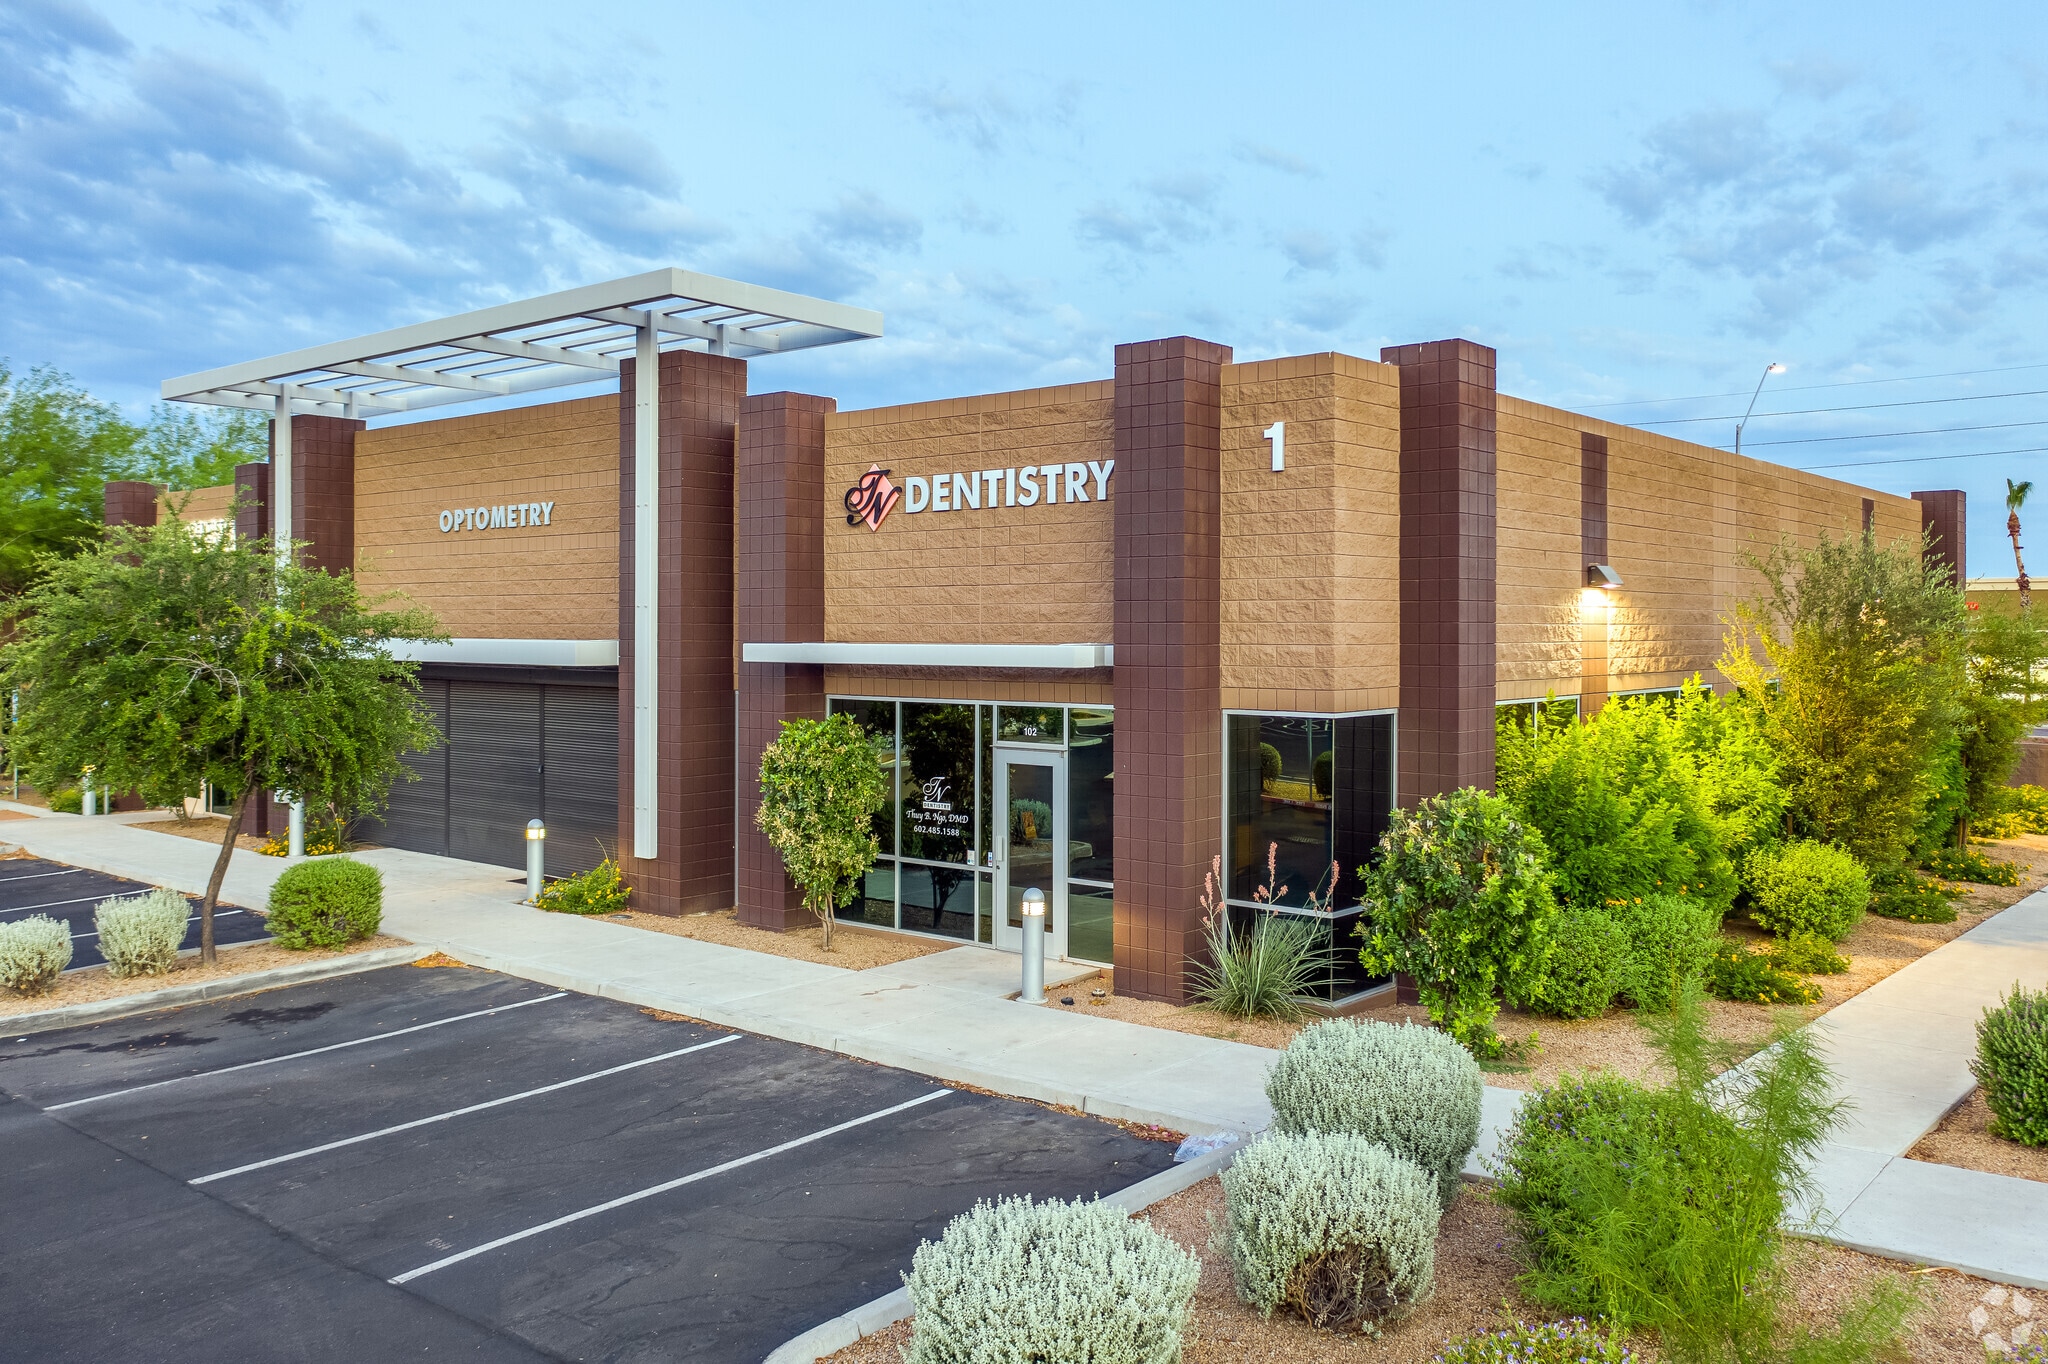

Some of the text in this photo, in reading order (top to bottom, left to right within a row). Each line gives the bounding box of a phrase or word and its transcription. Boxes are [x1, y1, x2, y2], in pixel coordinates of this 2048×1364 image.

[1263, 421, 1285, 471] 1
[905, 460, 1115, 514] DENTISTRY
[440, 501, 555, 533] OPTOMETRY
[1024, 727, 1037, 736] 102
[906, 809, 923, 822] Thuy
[932, 811, 948, 824] Ngo,
[948, 813, 969, 824] DMD
[914, 825, 960, 836] 602.485.1588
